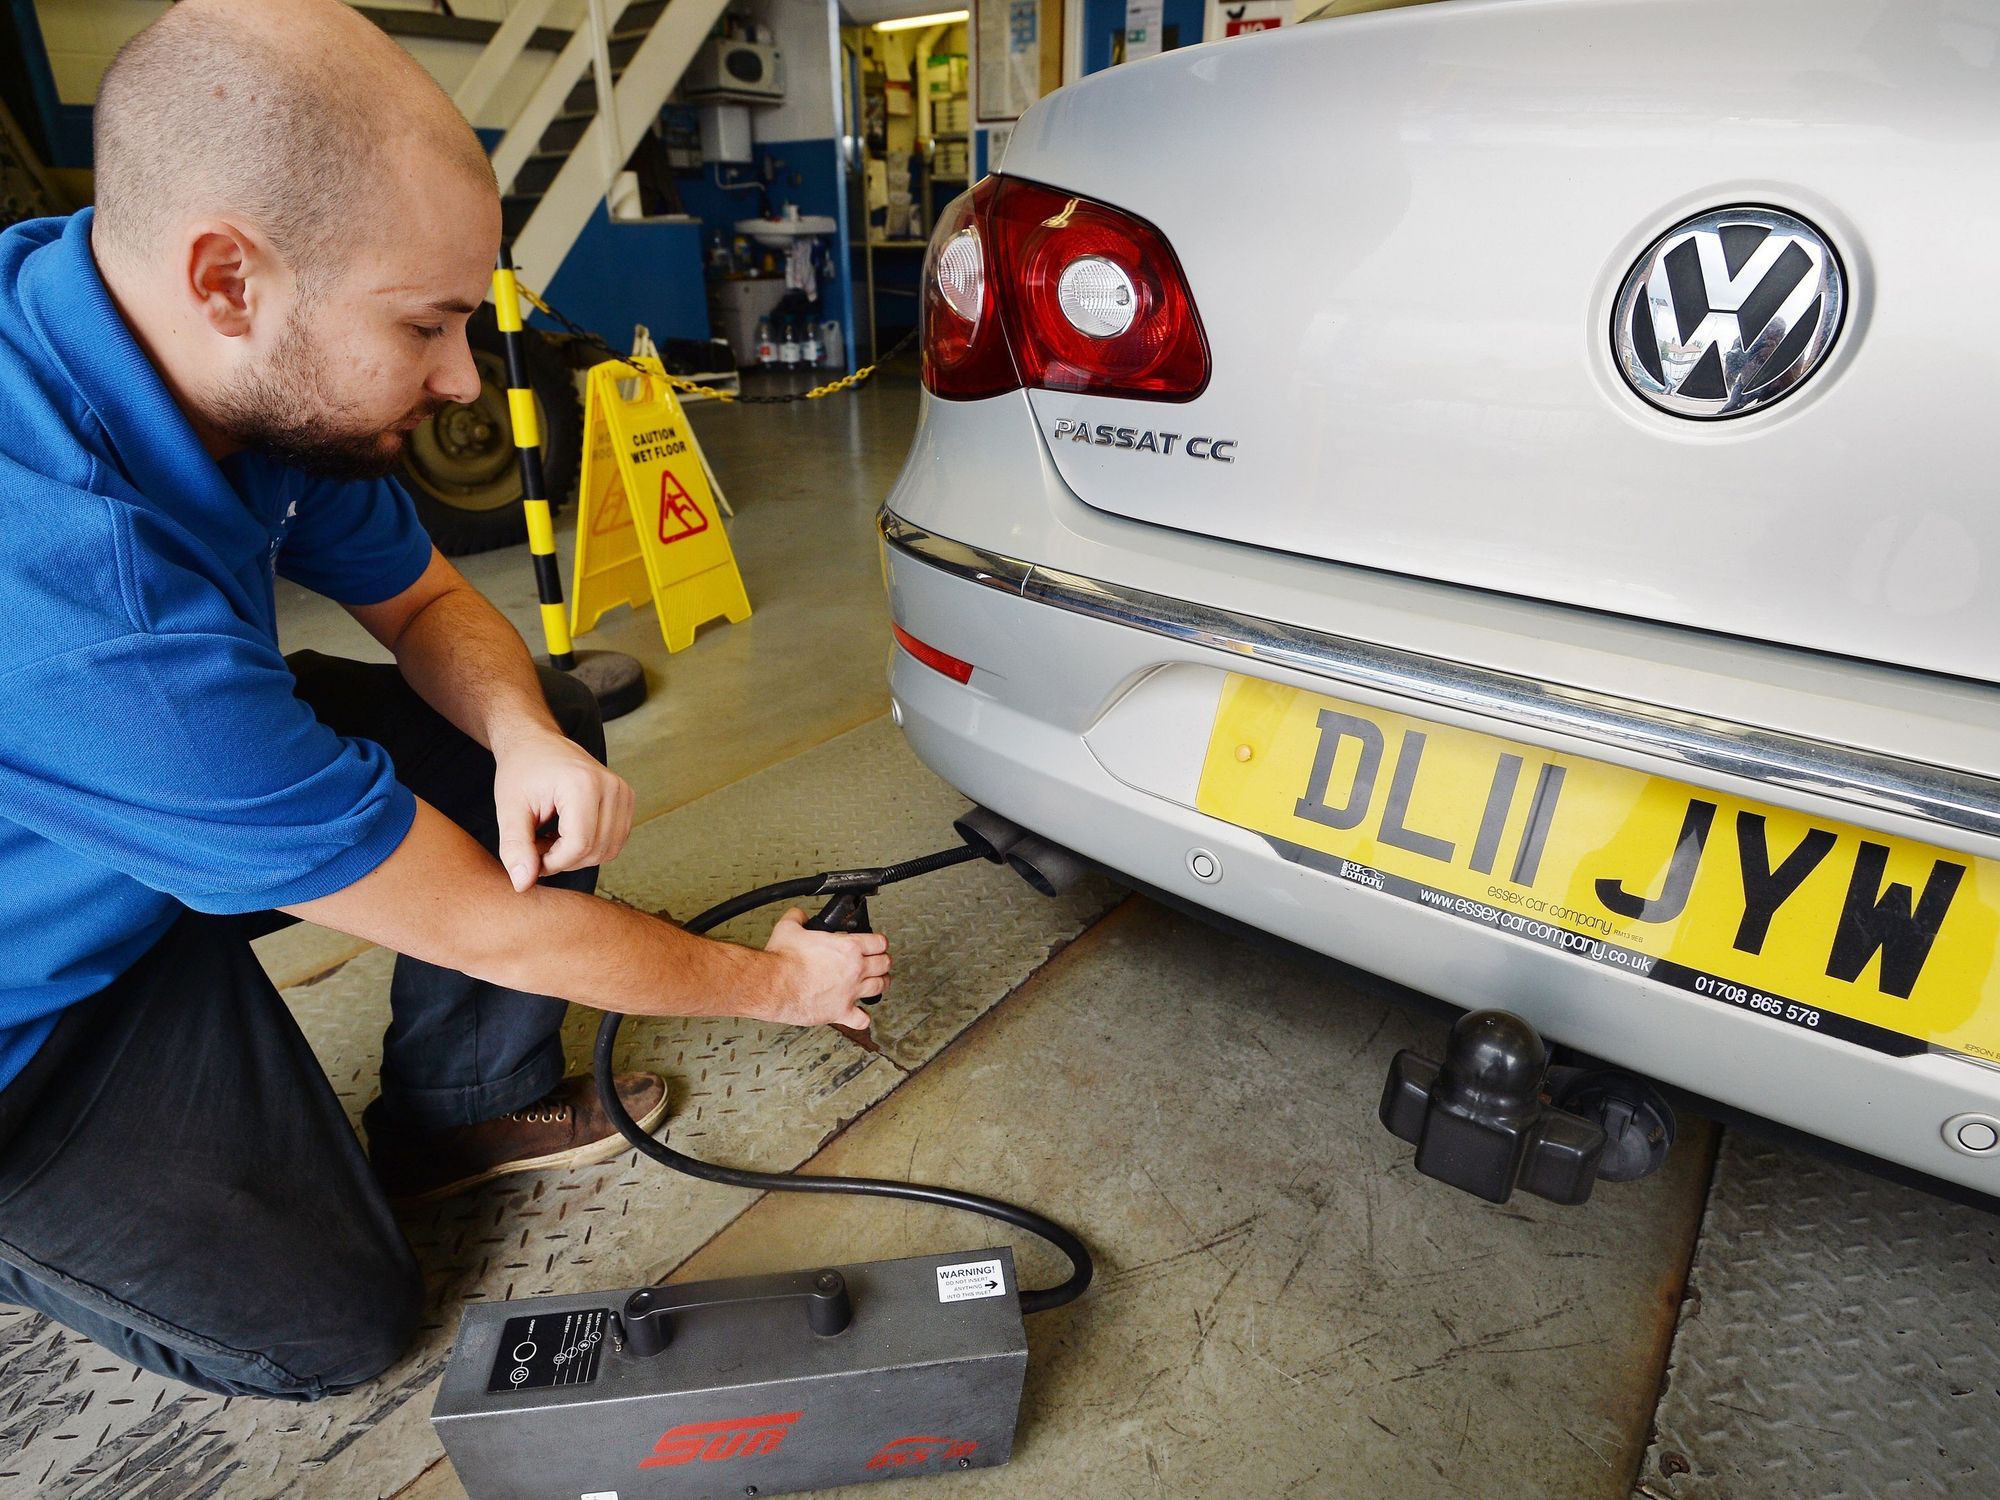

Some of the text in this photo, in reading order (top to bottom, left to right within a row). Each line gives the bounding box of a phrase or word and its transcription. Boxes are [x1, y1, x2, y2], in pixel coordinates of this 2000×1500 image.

[630, 448, 653, 465] WET
[654, 441, 687, 459] FLOOR
[632, 427, 676, 447] CAUTION
[1054, 418, 1239, 464] PASSAT CC
[1294, 707, 1967, 1000] DL11 JYW
[1346, 870, 1384, 891] company
[1487, 885, 1613, 936] essex car company
[1420, 888, 1651, 972] www.essexcarcompany.co.uk
[1695, 976, 1820, 1027] 01708 865 578
[939, 1266, 995, 1280] WARNING!
[953, 1284, 983, 1292] ANYTHING
